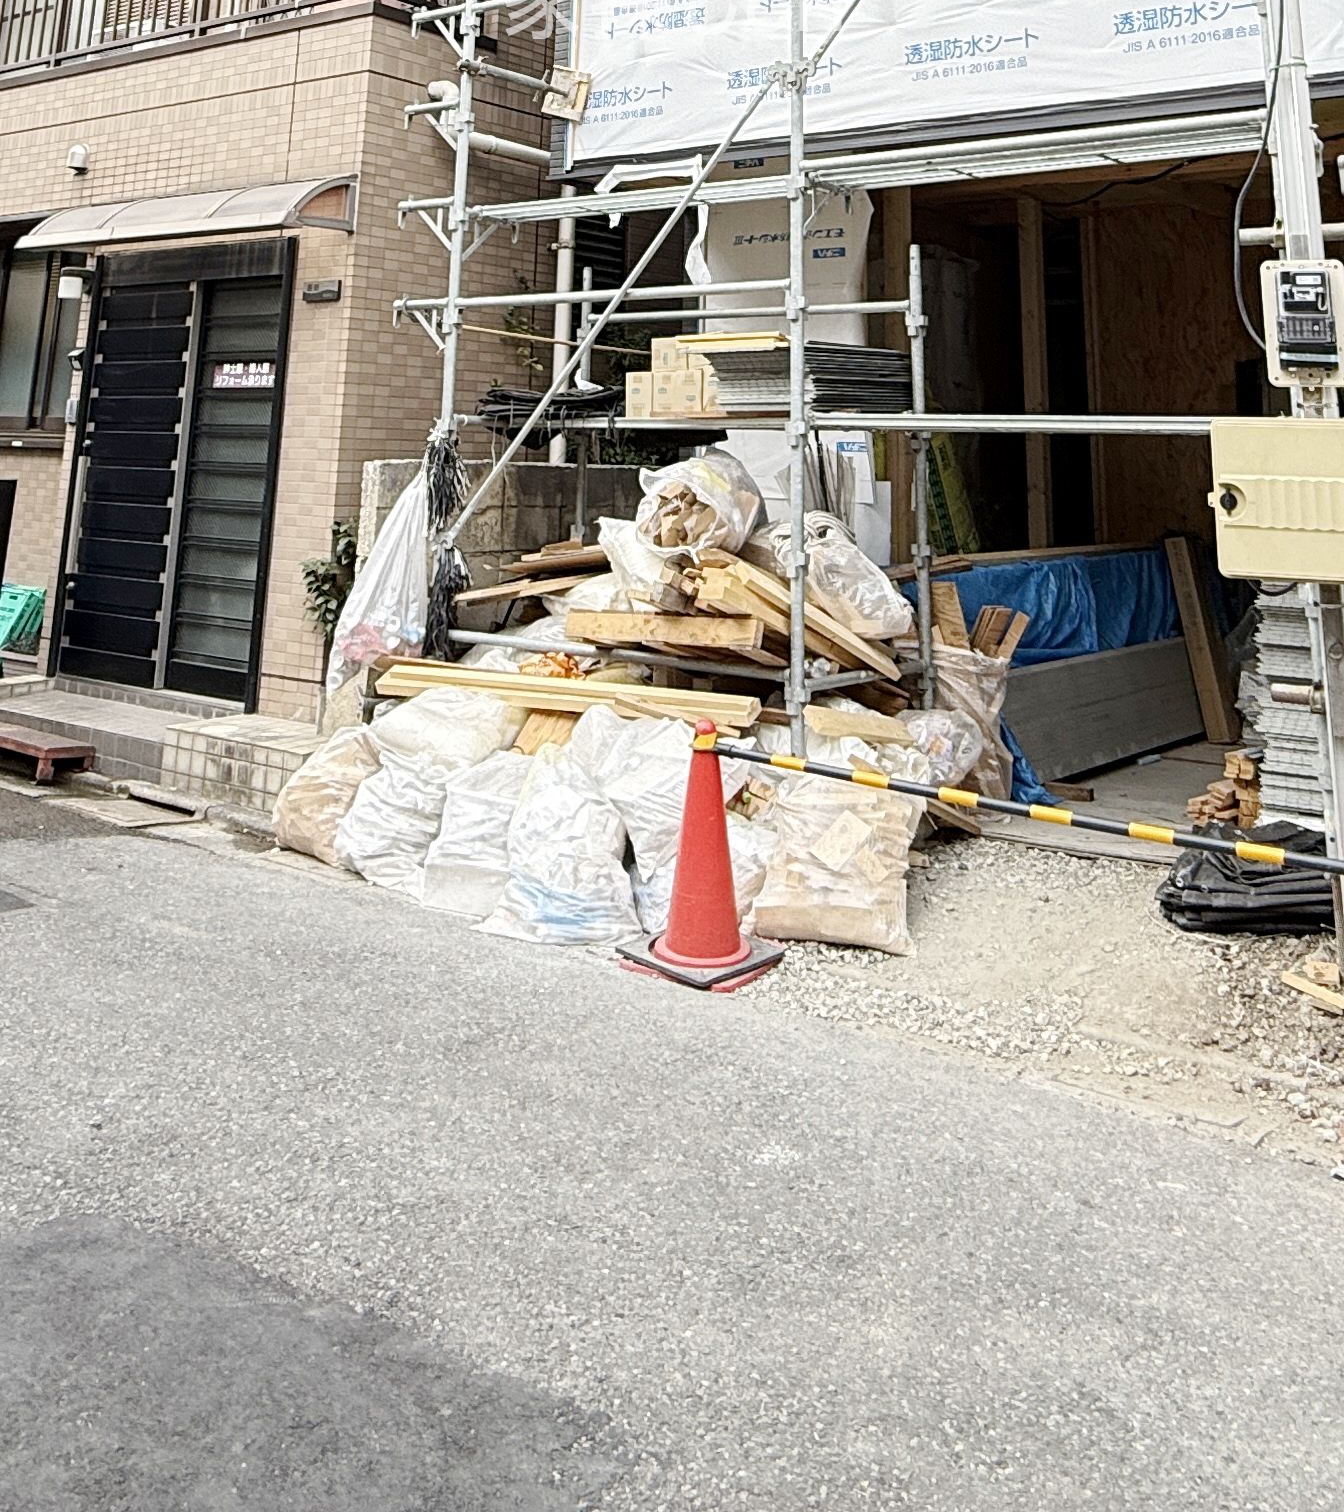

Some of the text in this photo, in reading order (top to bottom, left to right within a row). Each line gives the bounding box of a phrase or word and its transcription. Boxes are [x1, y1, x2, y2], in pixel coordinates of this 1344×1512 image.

[905, 28, 1039, 65] 透湿防水シート
[1123, 41, 1143, 55] JIS
[1146, 38, 1156, 50] A
[932, 68, 940, 79] A
